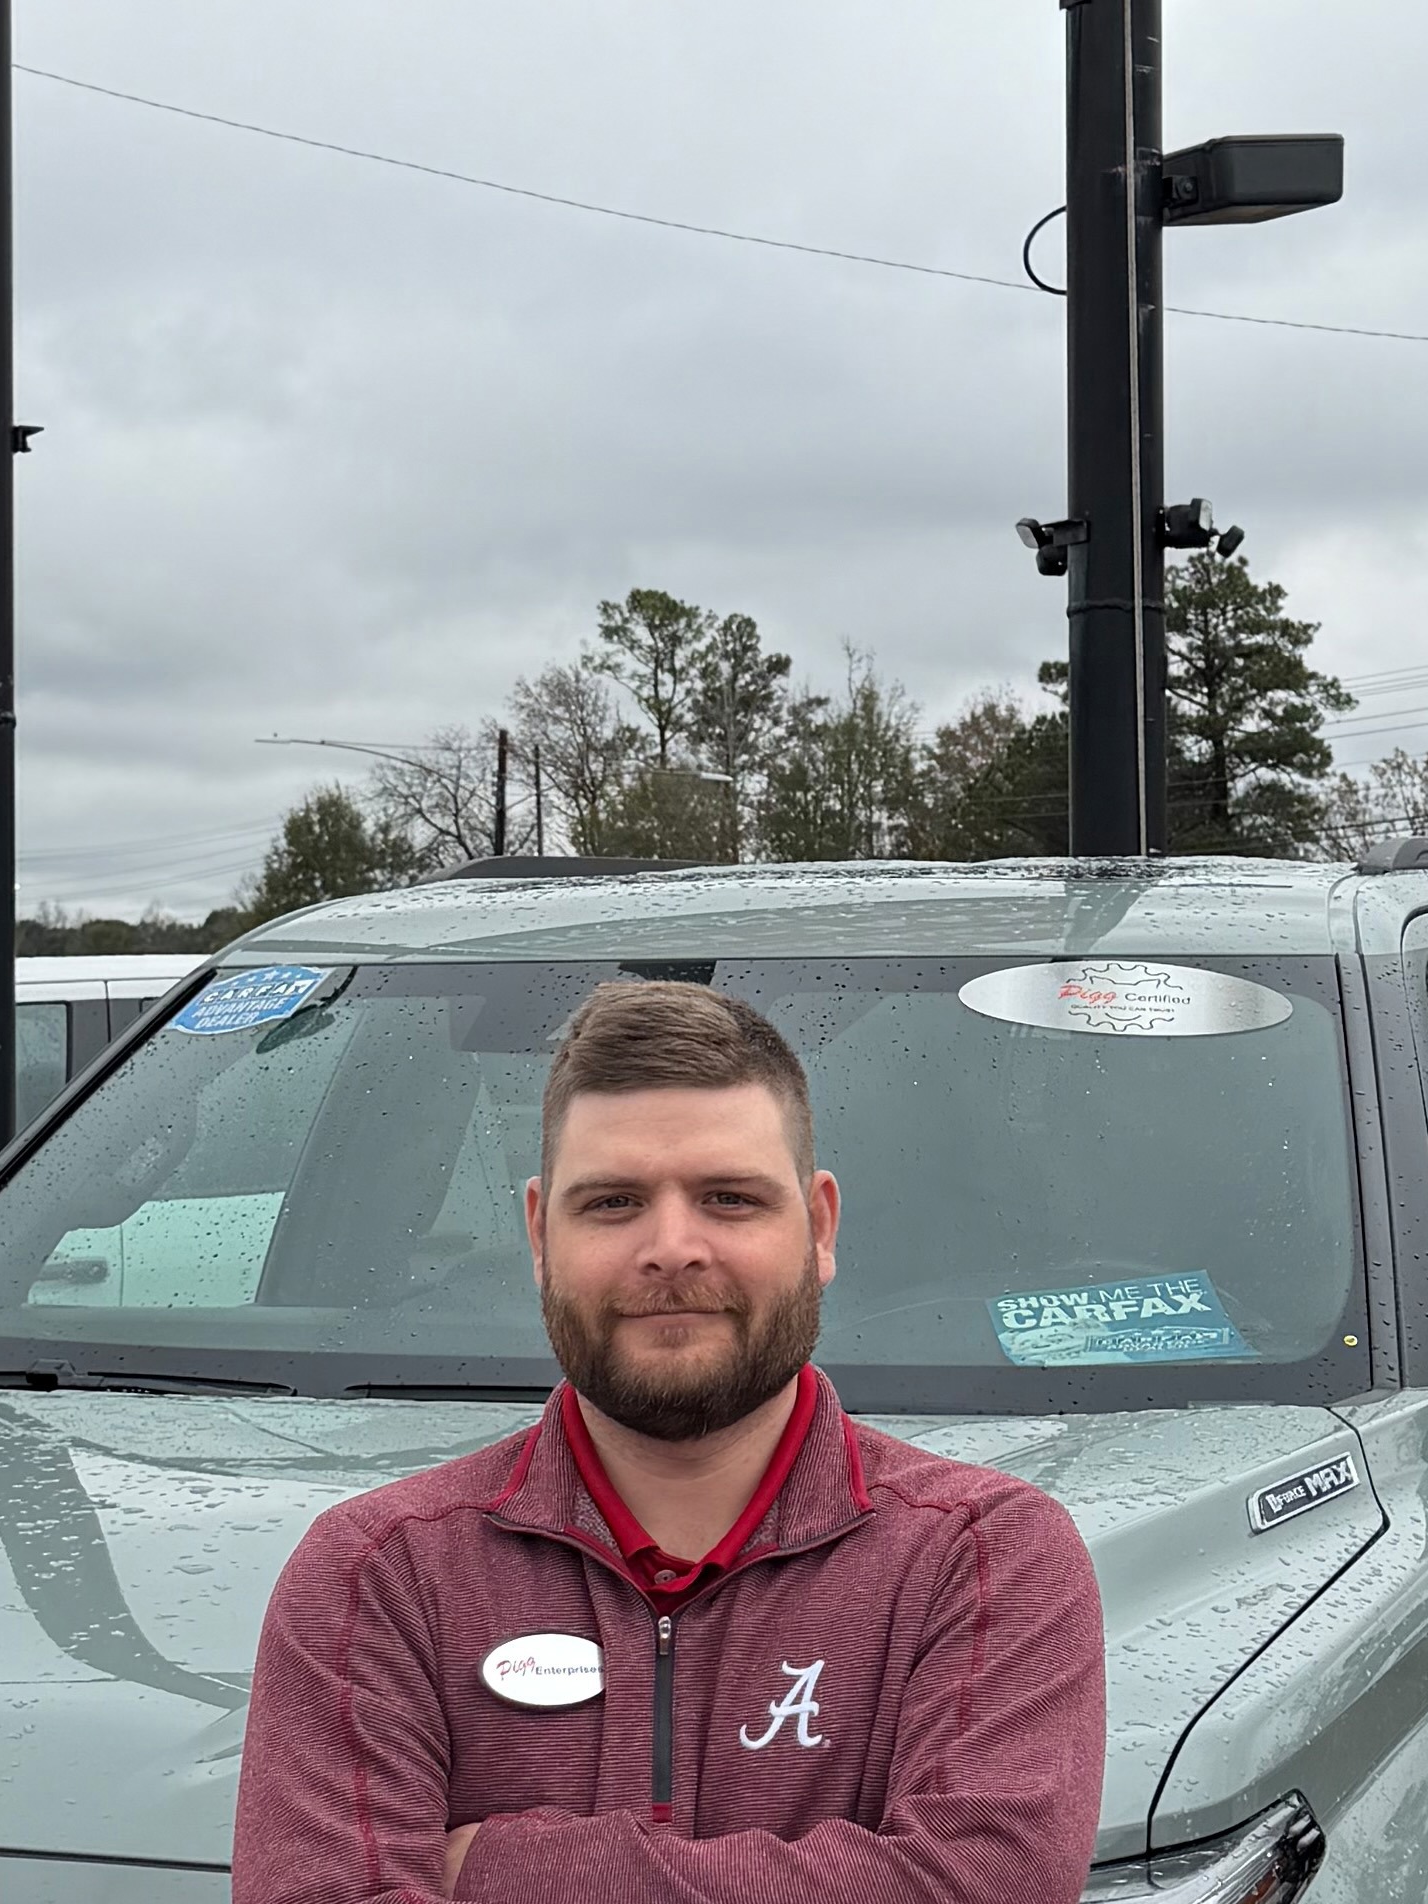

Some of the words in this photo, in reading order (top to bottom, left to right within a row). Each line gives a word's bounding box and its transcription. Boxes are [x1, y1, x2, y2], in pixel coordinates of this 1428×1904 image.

[192, 997, 288, 1018] ADVANTAGE
[1058, 984, 1117, 1005] Pigg
[1125, 993, 1191, 1005] Certified
[194, 1012, 260, 1029] DEALER
[997, 1292, 1090, 1313] SHOW
[1099, 1285, 1144, 1303] ME
[1146, 1278, 1200, 1296] THE
[1001, 1292, 1212, 1330] CARFAX
[1304, 1461, 1353, 1497] MAX
[496, 1656, 536, 1681] Pigg
[535, 1665, 604, 1676] Enterprises
[739, 1659, 826, 1750] A
